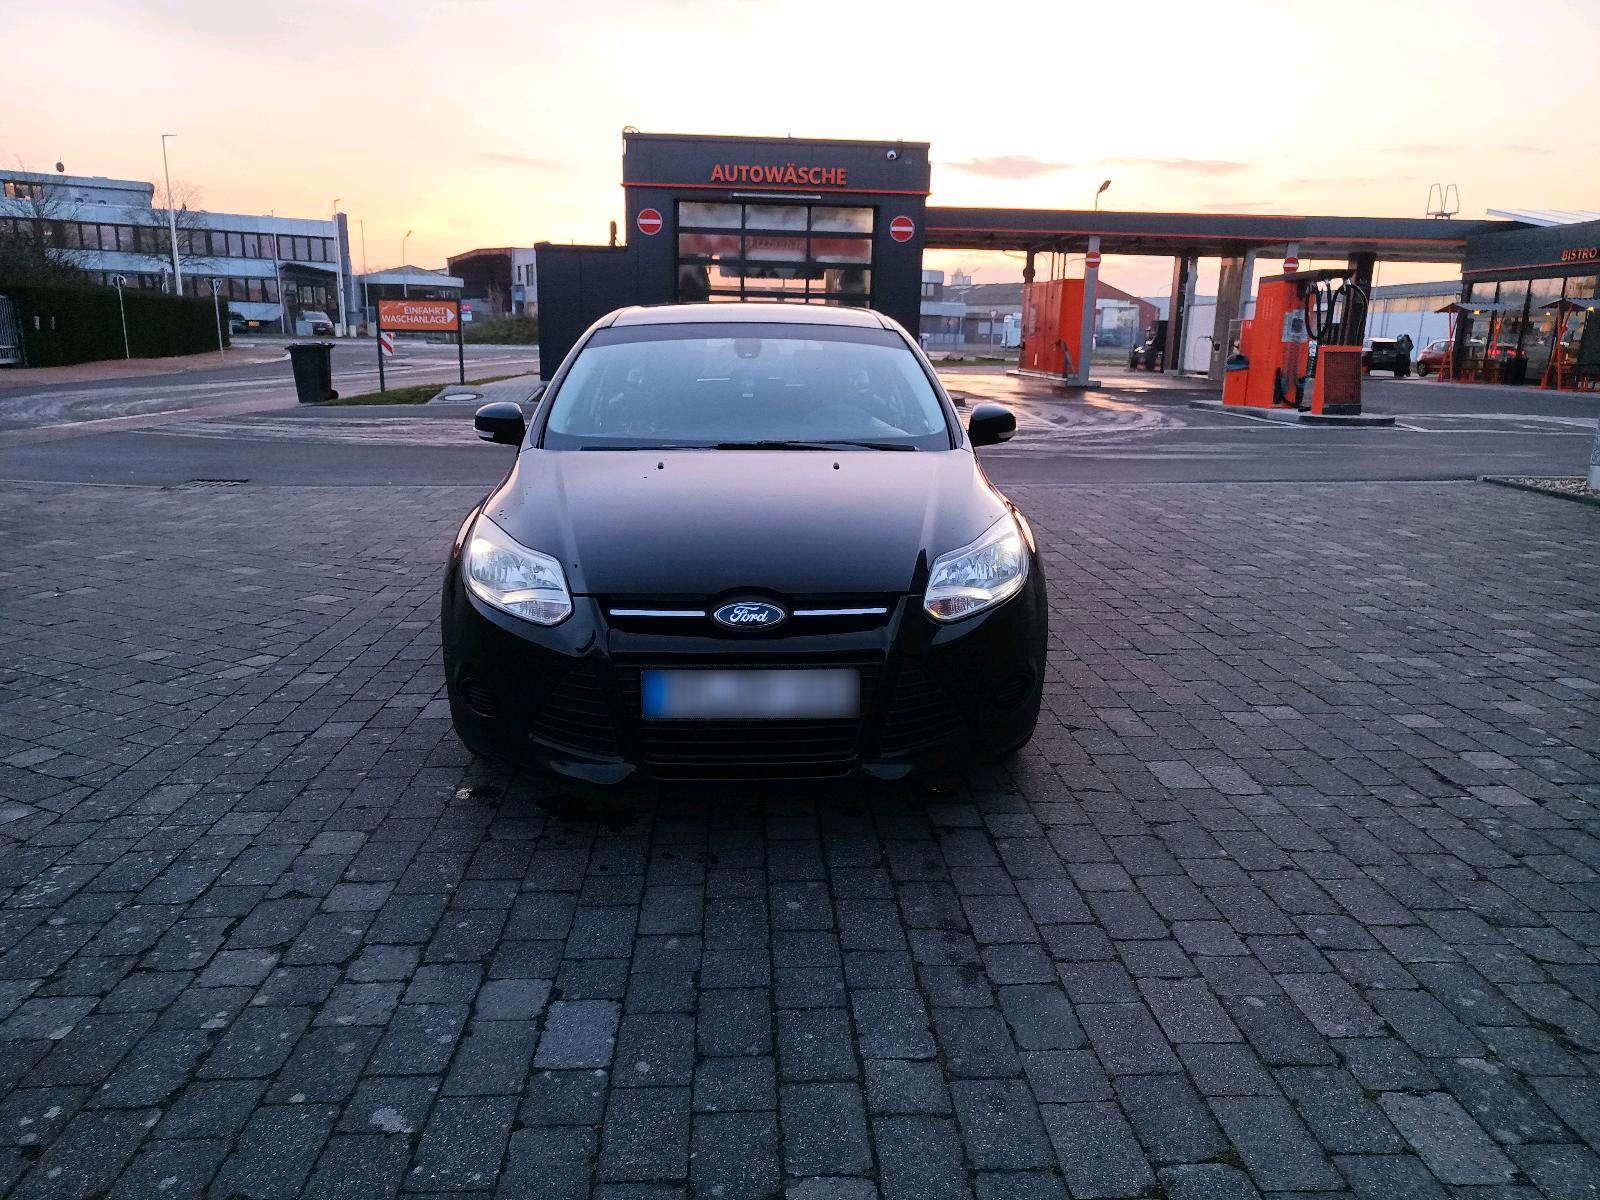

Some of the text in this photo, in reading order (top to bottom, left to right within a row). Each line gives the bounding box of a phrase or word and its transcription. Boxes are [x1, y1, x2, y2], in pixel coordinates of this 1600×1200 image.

[710, 162, 847, 185] AUTOWÄSCHE
[1561, 247, 1598, 261] BISTRO
[403, 306, 446, 315] EINFAHRT
[381, 315, 448, 324] WASCHANLAGE
[729, 605, 769, 622] Ford
